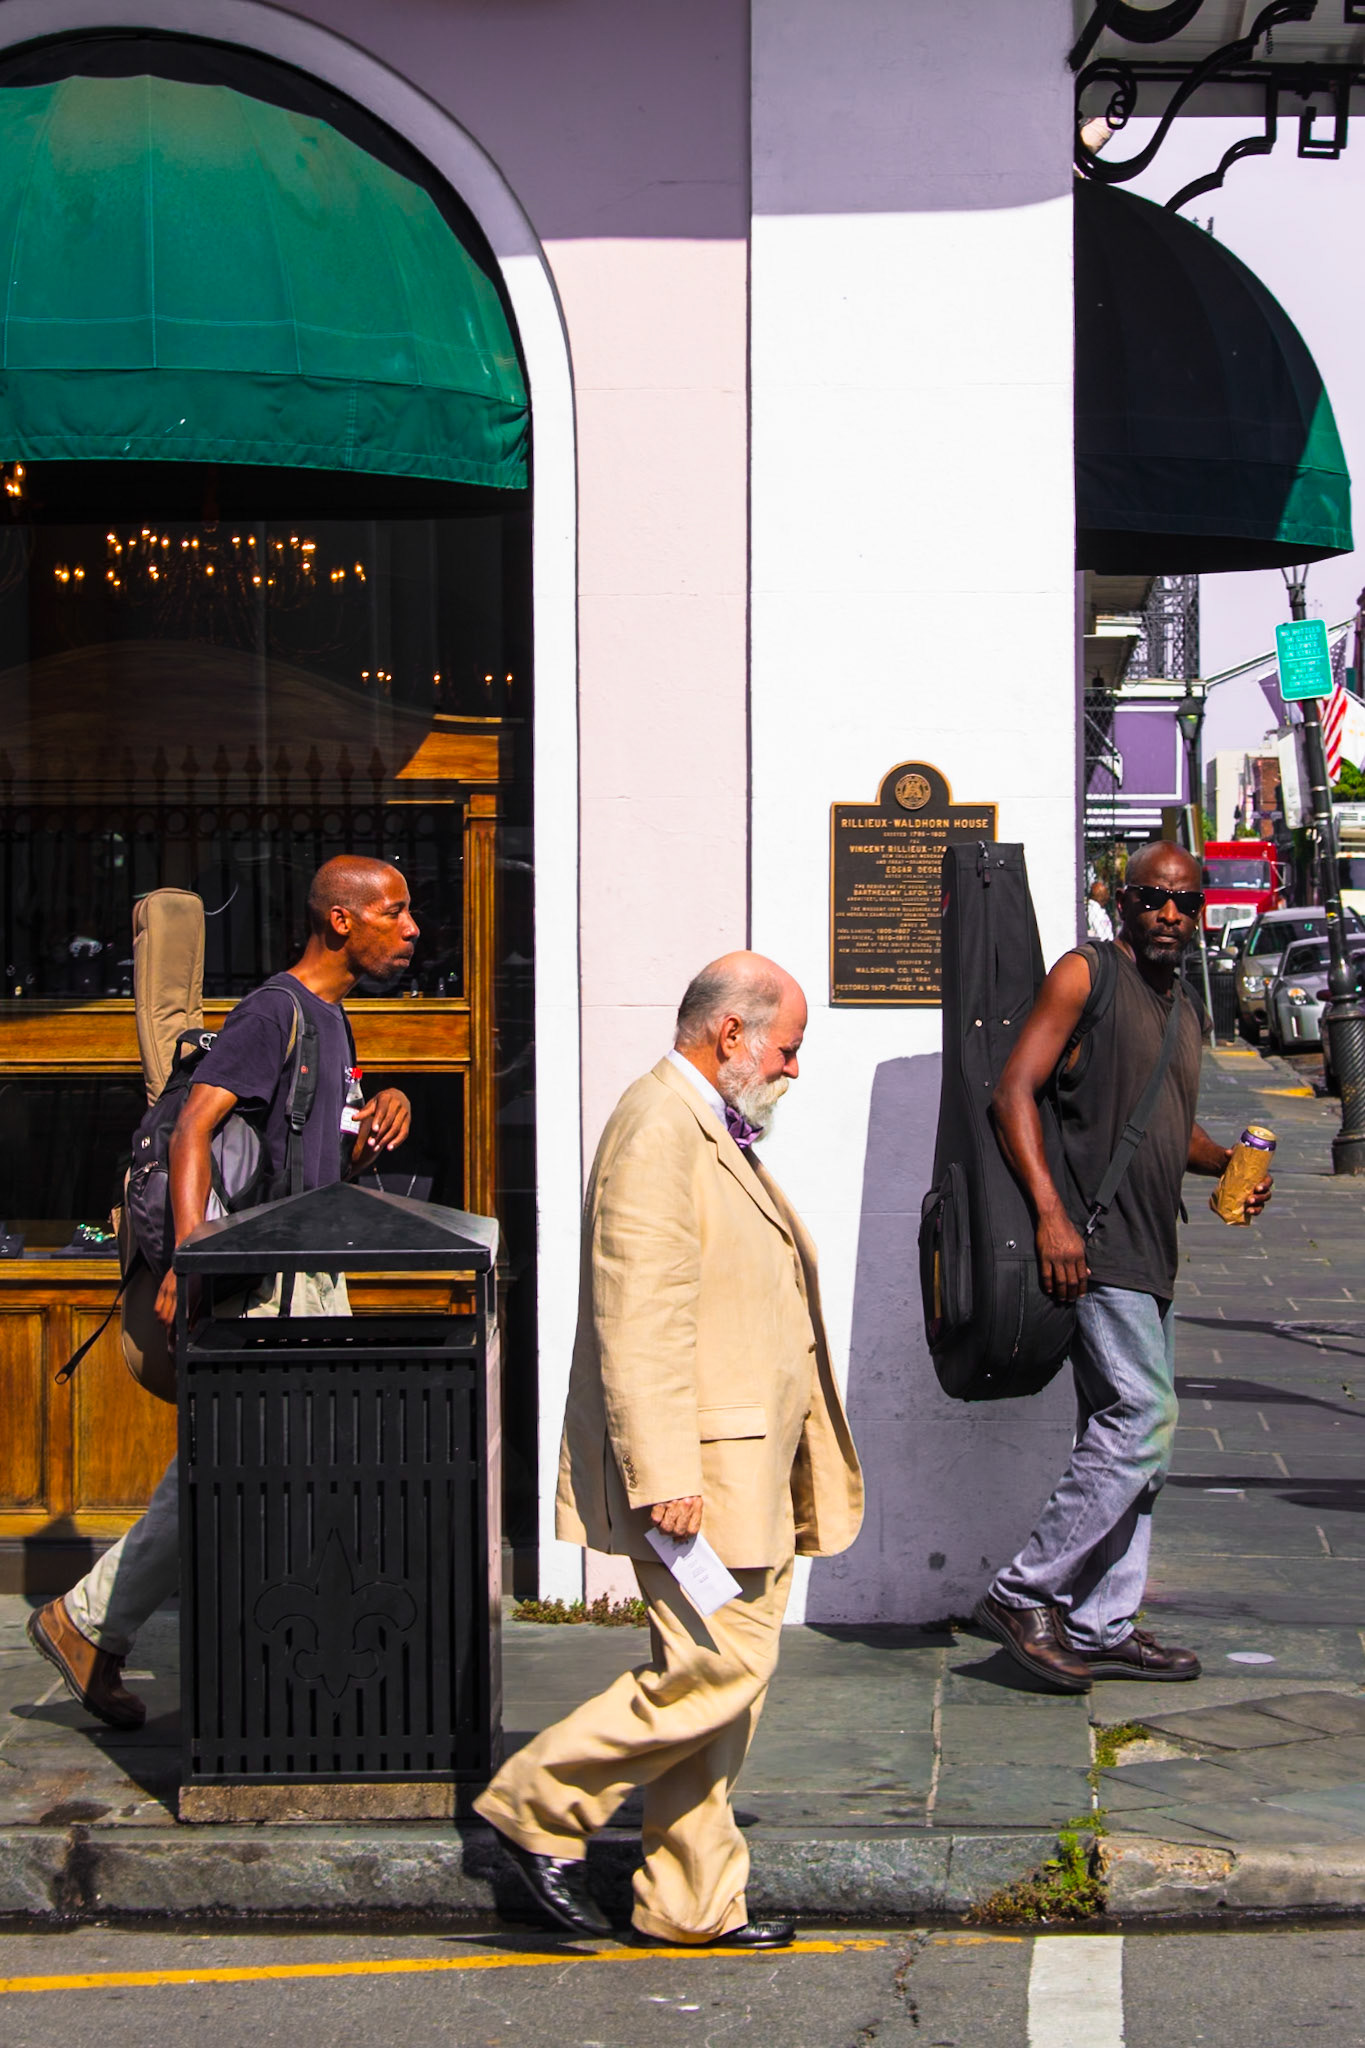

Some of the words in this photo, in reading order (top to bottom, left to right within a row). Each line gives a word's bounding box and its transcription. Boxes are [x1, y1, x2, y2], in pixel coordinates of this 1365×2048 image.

[841, 819, 950, 828] RILLIEUX-WALDHORN
[954, 819, 989, 828] HOUSE
[849, 845, 885, 853] VINCENT
